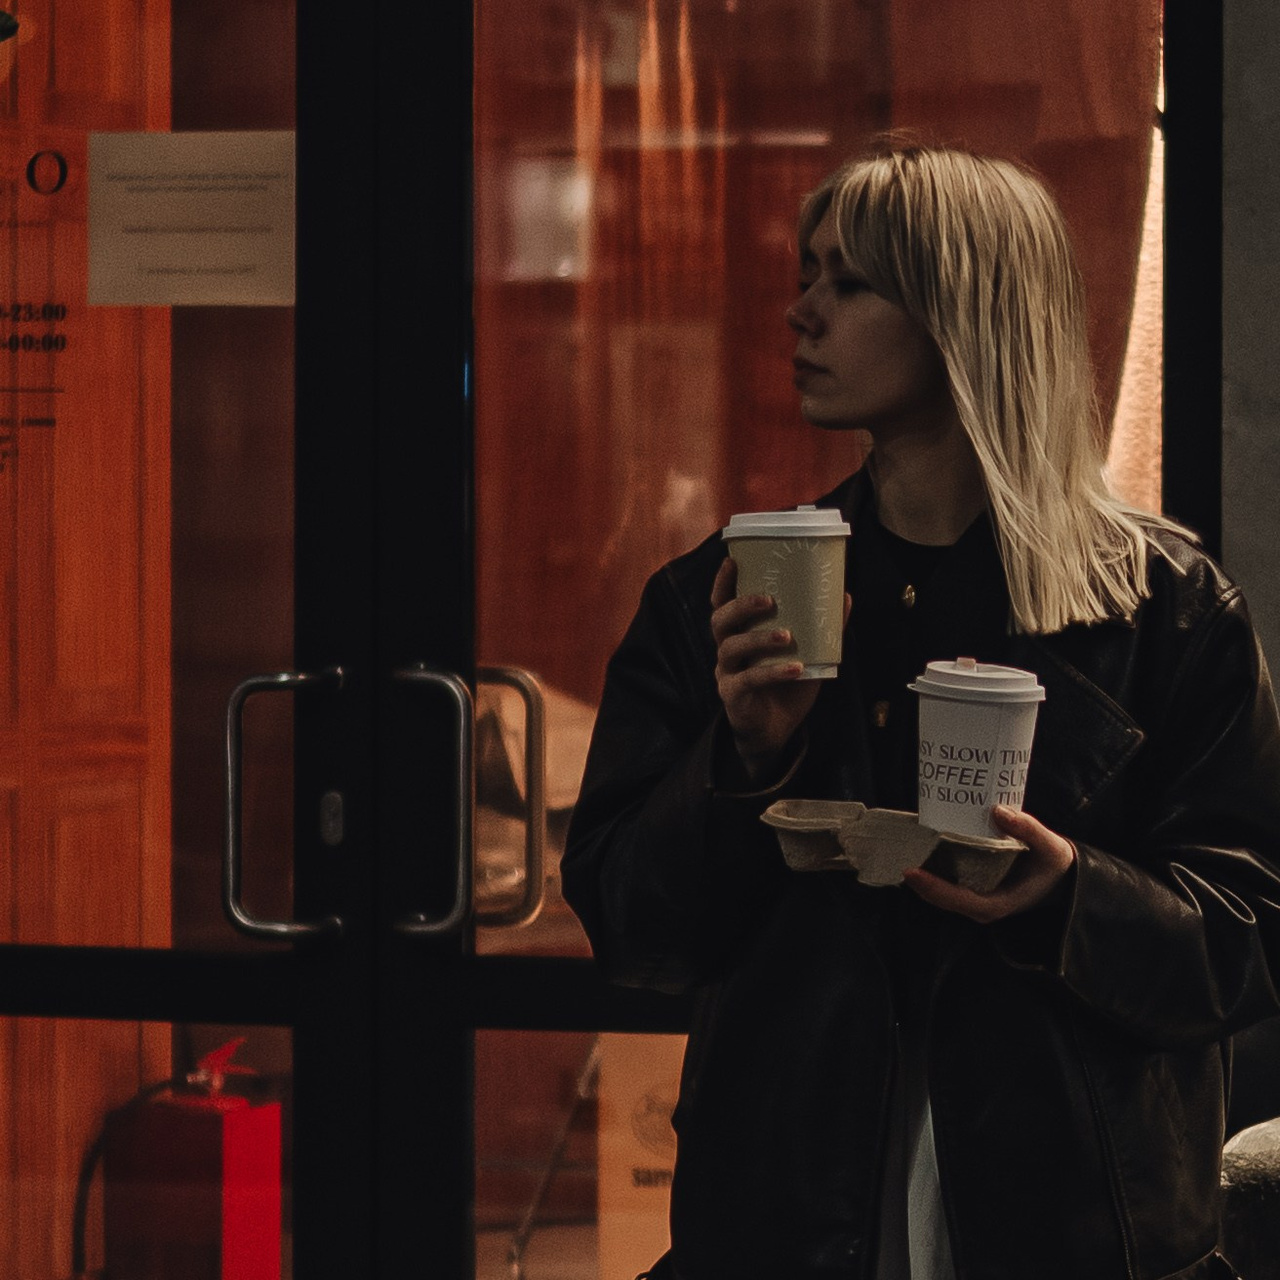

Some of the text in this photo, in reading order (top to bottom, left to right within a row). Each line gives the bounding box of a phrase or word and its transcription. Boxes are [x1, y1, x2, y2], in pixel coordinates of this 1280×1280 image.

[0, 303, 67, 322] -23:00
[920, 740, 934, 756] SY
[940, 744, 995, 764] SLOW
[937, 786, 989, 805] SLOW
